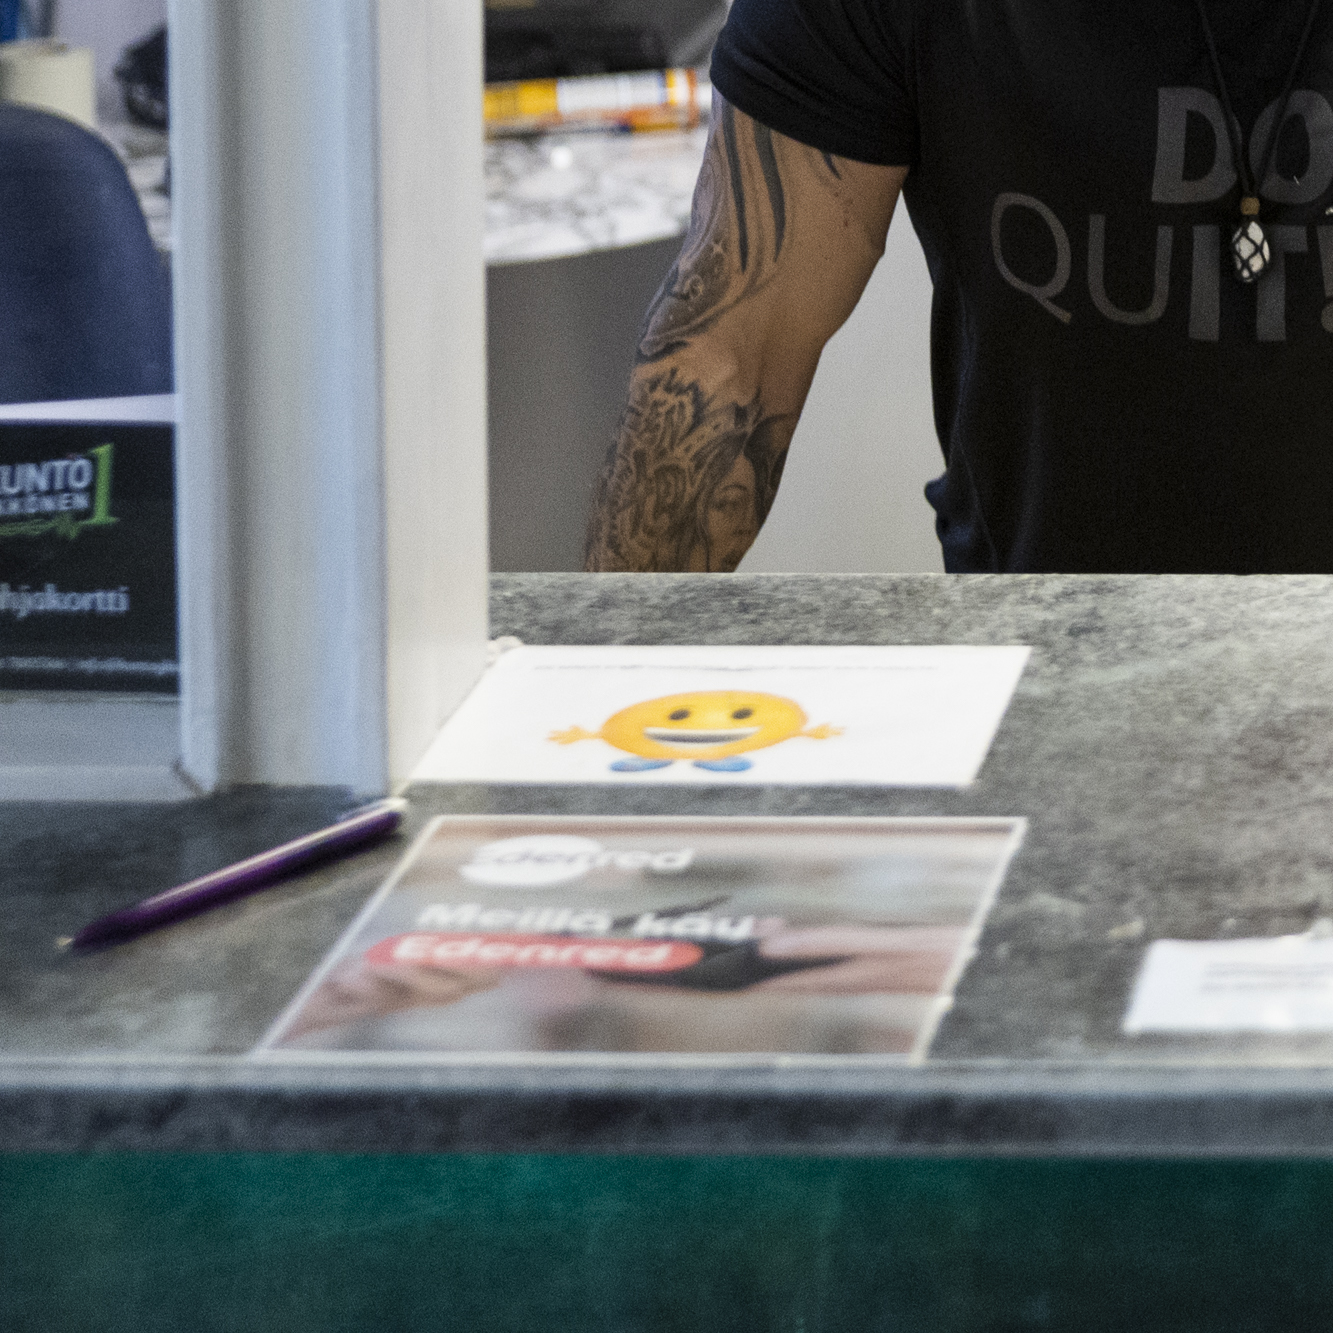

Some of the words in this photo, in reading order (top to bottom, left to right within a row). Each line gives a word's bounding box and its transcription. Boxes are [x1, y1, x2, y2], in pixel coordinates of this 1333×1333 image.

[0, 456, 93, 496] UNTO
[416, 902, 614, 936] Meillä
[632, 912, 757, 944] käy
[391, 934, 674, 967] Edenred
